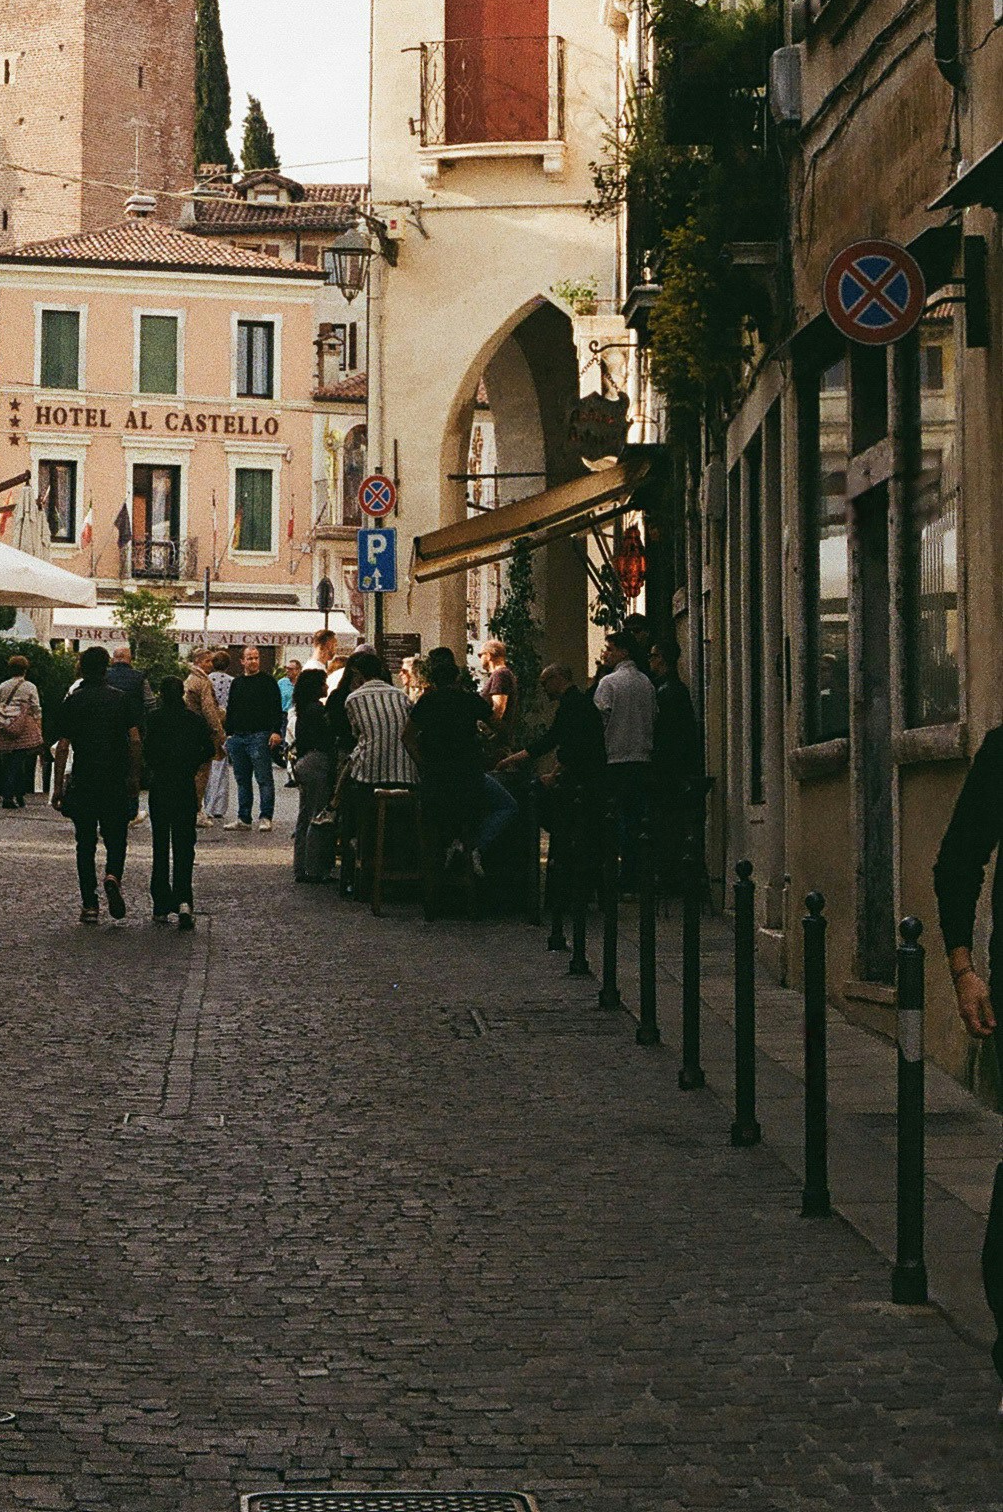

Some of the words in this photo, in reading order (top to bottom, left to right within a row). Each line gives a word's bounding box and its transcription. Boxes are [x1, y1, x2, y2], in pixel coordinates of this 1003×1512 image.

[35, 405, 112, 428] HOTEL
[125, 410, 153, 430] AL
[165, 412, 279, 436] CASTELLO
[367, 534, 387, 565] P
[75, 627, 102, 640] BAR
[218, 633, 238, 644] AL
[243, 634, 314, 645] CASTELLO
